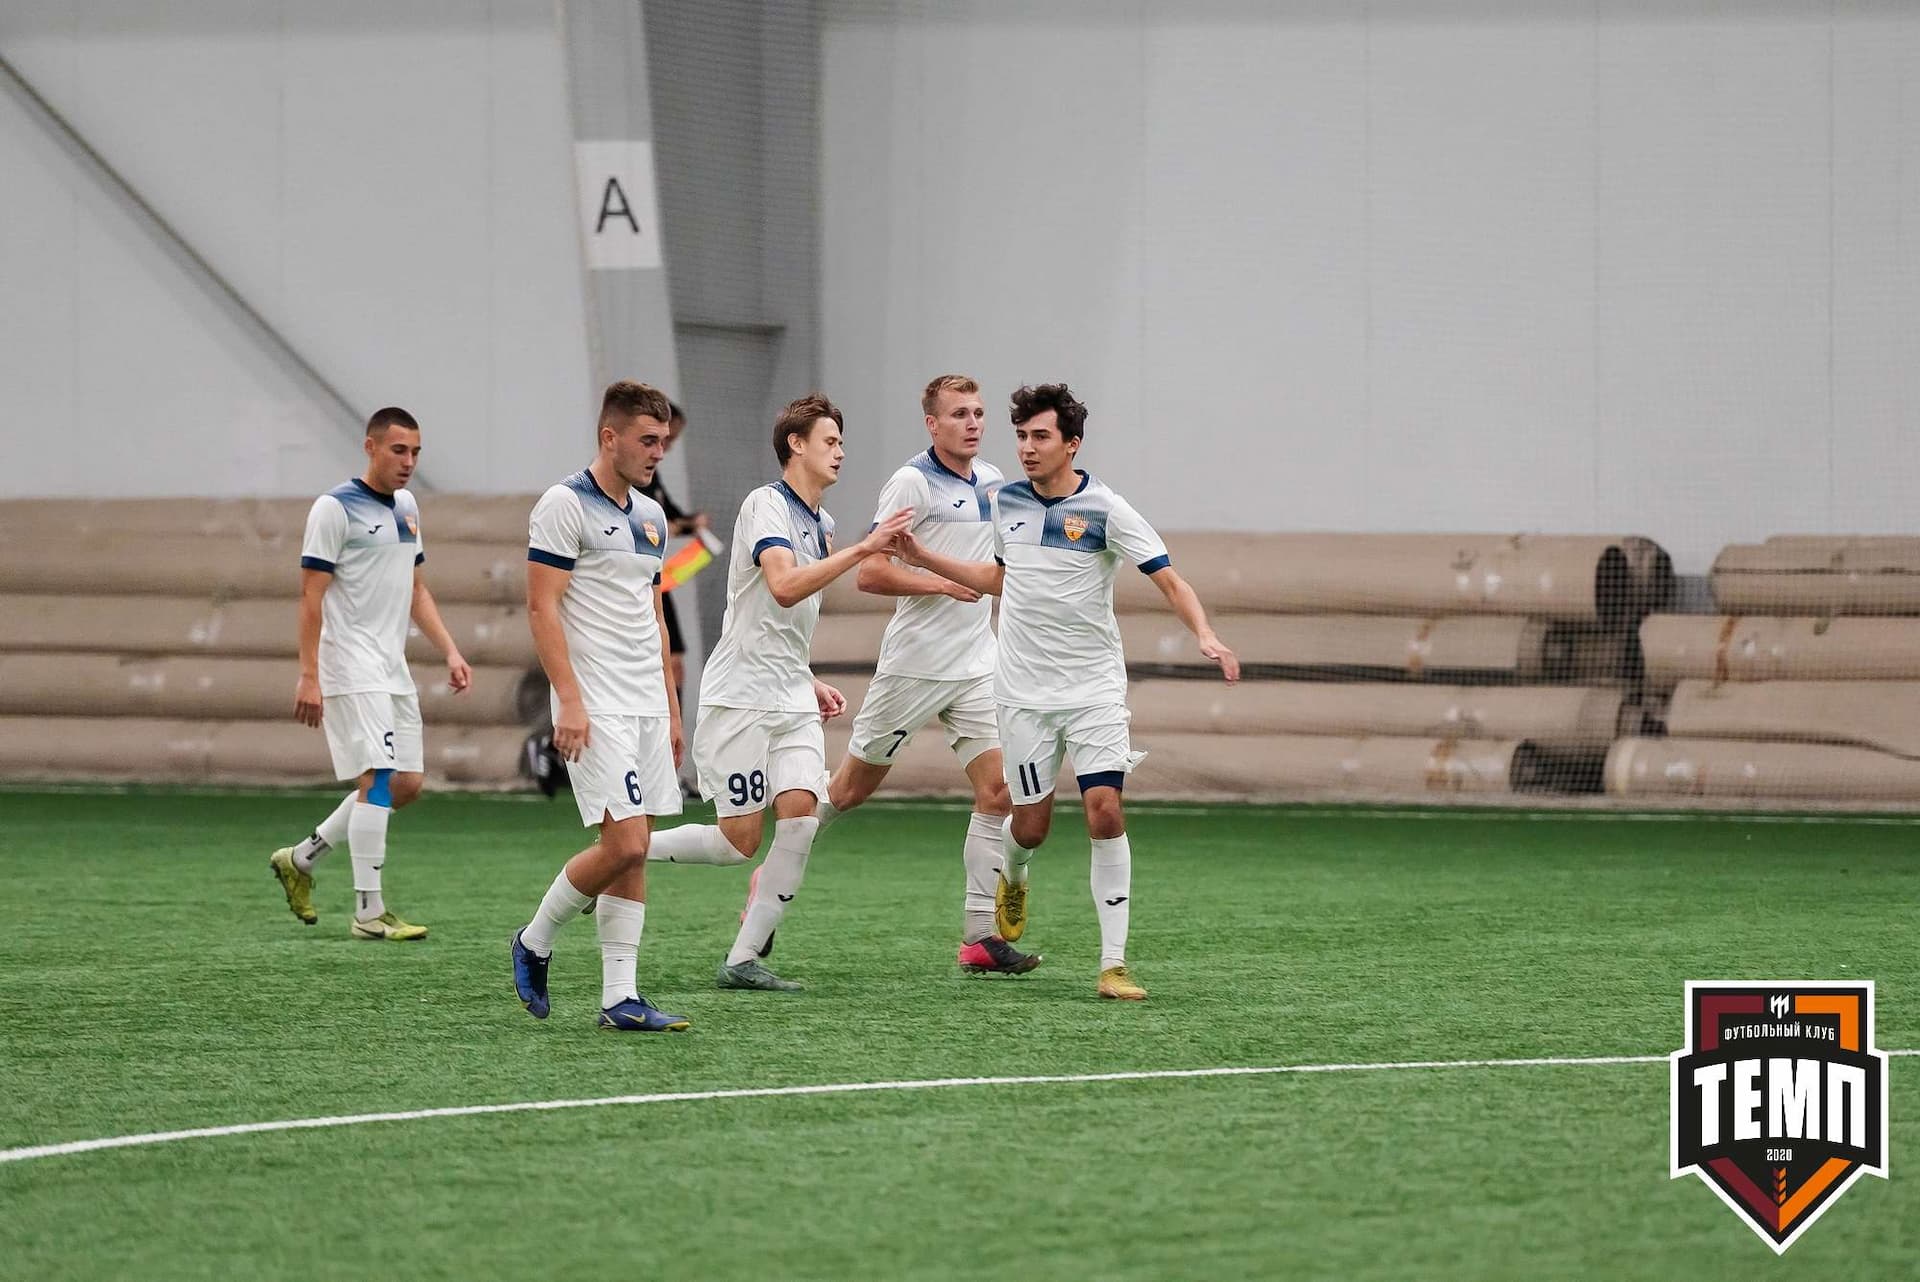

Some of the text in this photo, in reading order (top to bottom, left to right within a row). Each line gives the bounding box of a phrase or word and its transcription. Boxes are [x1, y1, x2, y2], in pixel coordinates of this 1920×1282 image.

[597, 177, 639, 233] A
[885, 729, 907, 758] 7
[624, 770, 642, 805] 6
[728, 769, 765, 806] 98
[1018, 762, 1041, 796] 11
